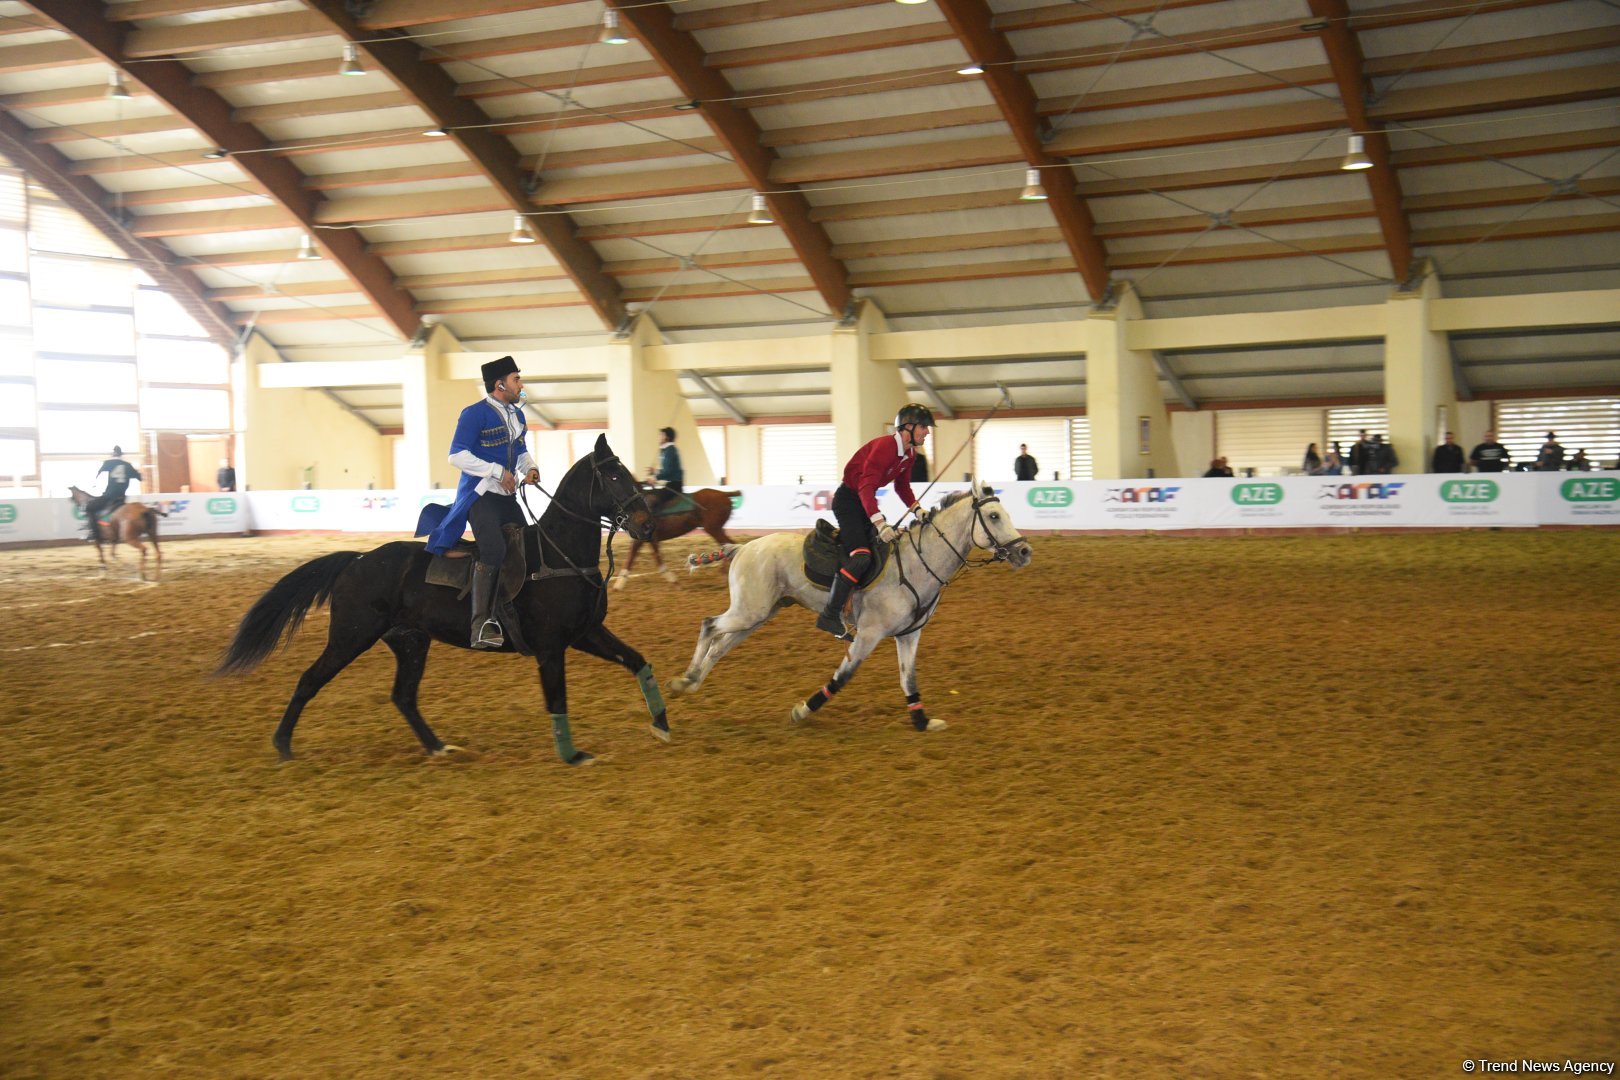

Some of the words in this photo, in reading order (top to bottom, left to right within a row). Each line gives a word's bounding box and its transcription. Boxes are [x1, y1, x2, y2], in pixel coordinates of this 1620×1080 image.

[1033, 490, 1067, 504] AZE
[1238, 486, 1276, 501] AZE
[1447, 483, 1491, 499] AZE
[1569, 481, 1615, 498] AZE
